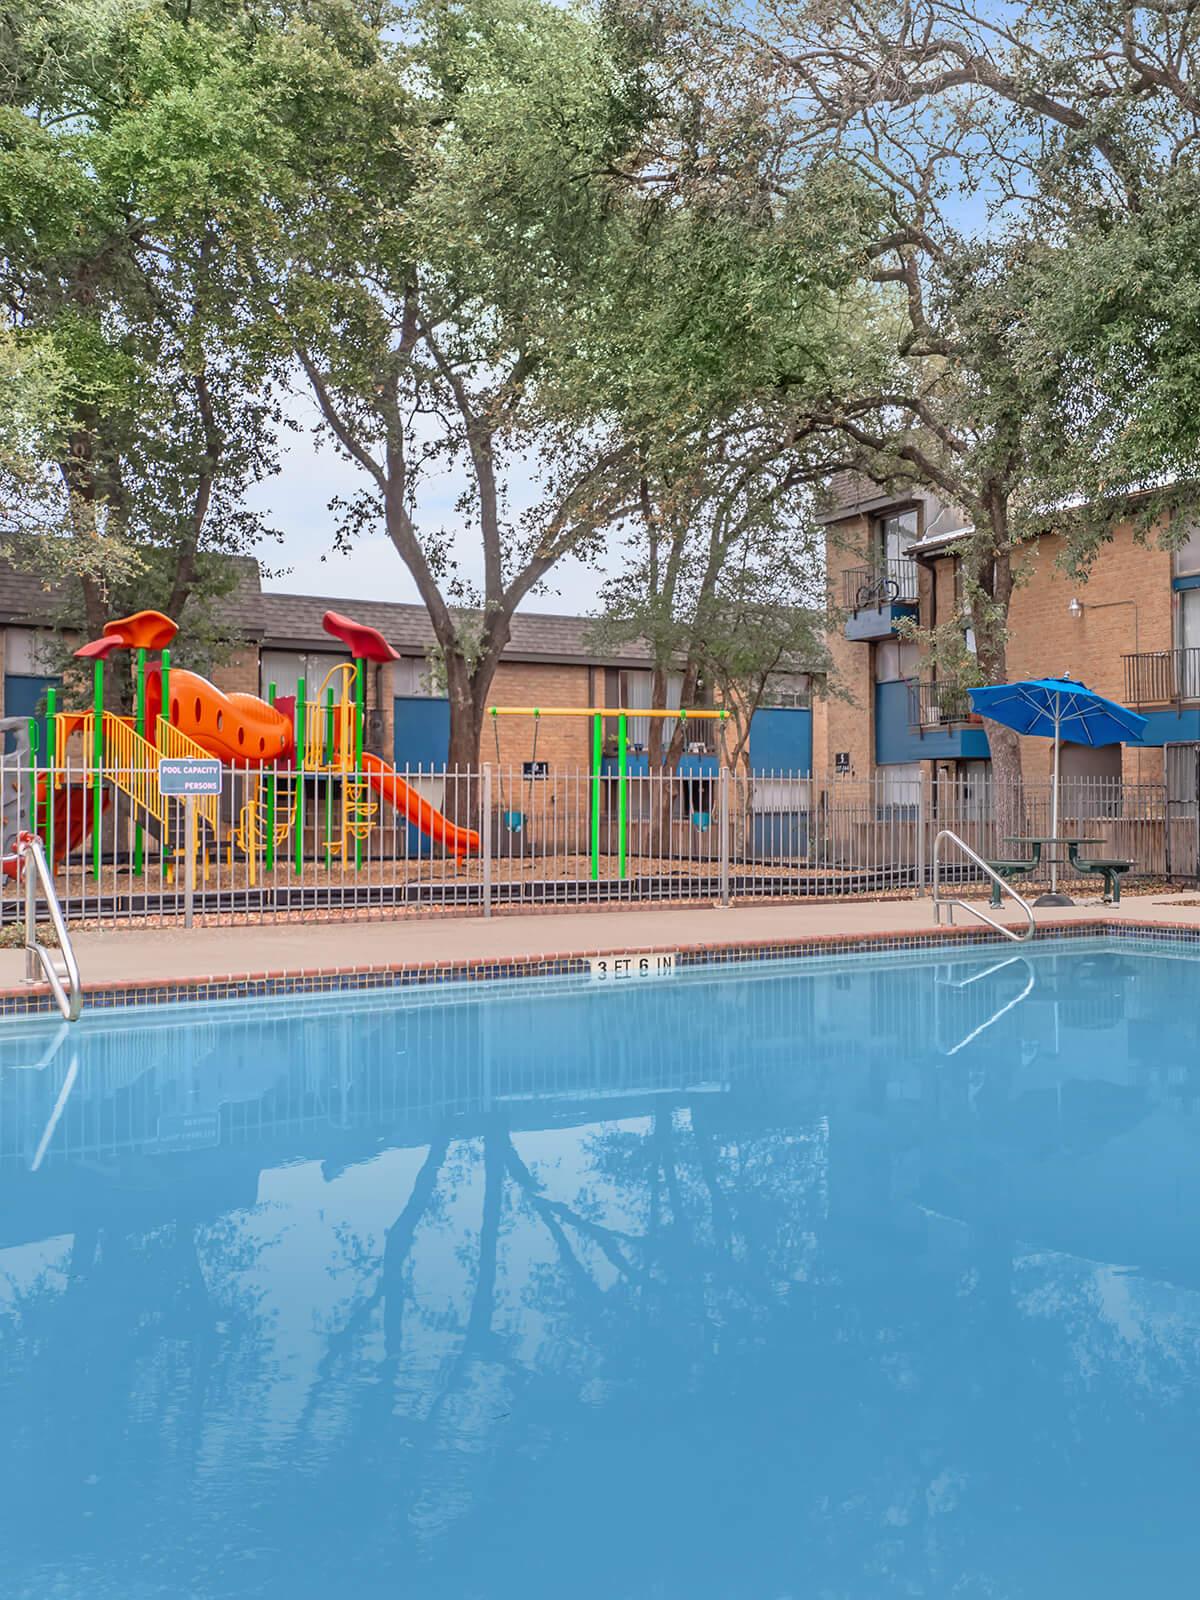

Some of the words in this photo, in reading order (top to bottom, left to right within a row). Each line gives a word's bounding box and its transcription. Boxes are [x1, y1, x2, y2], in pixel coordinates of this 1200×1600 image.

[162, 766, 182, 774] POOL
[183, 766, 218, 774] CAPACITY
[184, 782, 217, 790] PERSONS
[598, 961, 607, 975] 3
[639, 958, 649, 973] 6
[657, 956, 672, 973] IN
